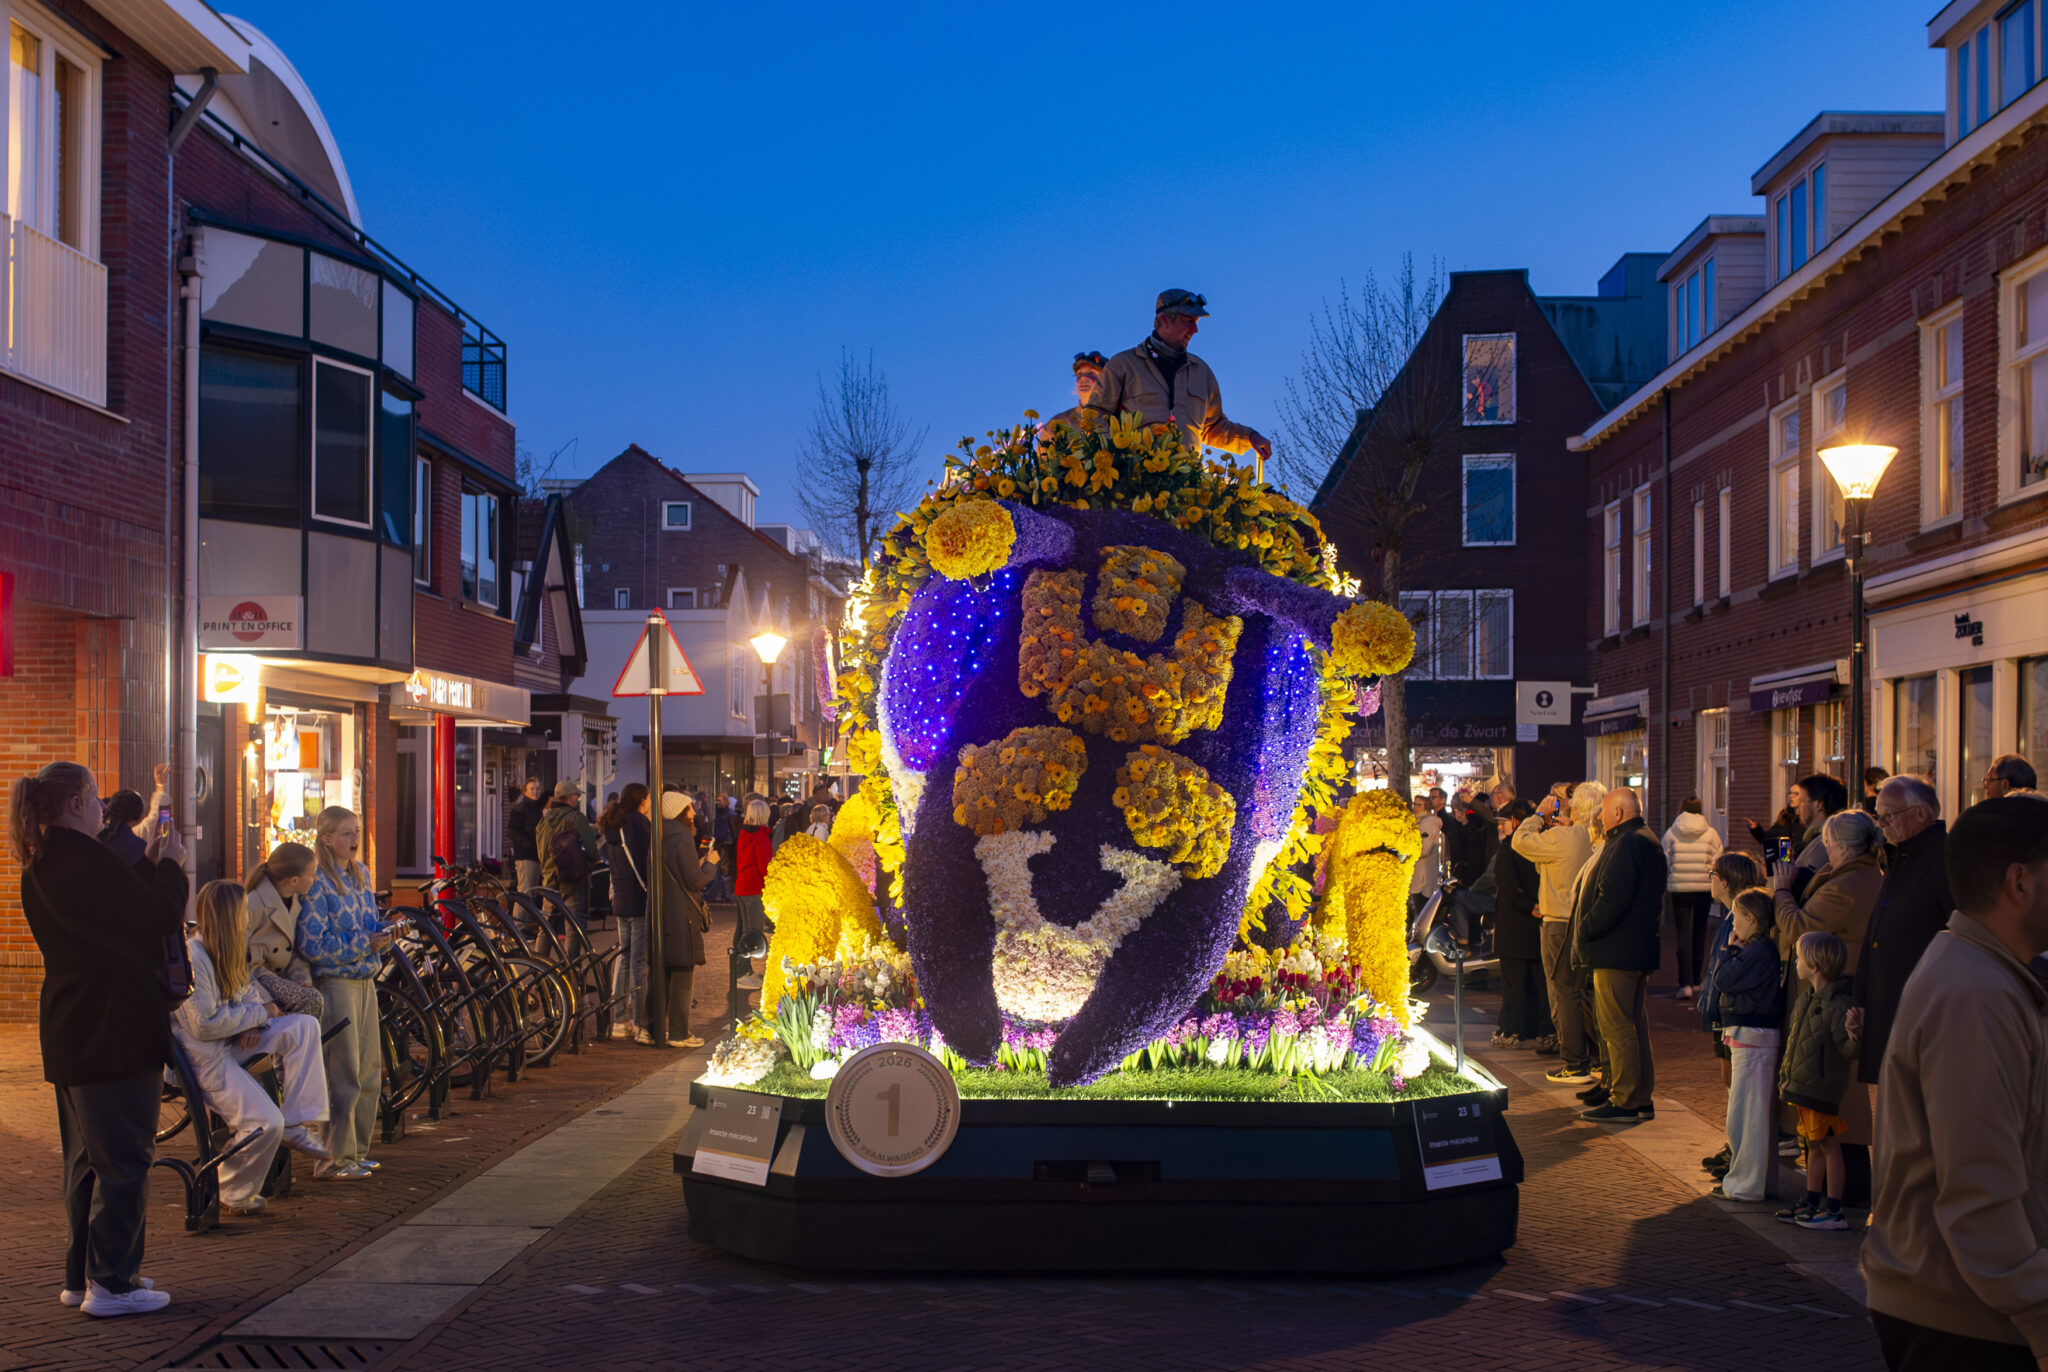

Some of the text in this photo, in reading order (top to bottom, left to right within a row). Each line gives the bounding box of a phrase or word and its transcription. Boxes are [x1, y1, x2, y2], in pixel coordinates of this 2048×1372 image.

[203, 621, 293, 632] PRINT EN OFFICE
[1440, 724, 1459, 738] de
[1464, 723, 1507, 738] Zwart
[878, 1055, 913, 1068] 2026
[746, 1104, 757, 1115] 23
[876, 1083, 901, 1137] 1
[1458, 1106, 1468, 1117] 23
[860, 1144, 924, 1162] PRAALWAGENS
